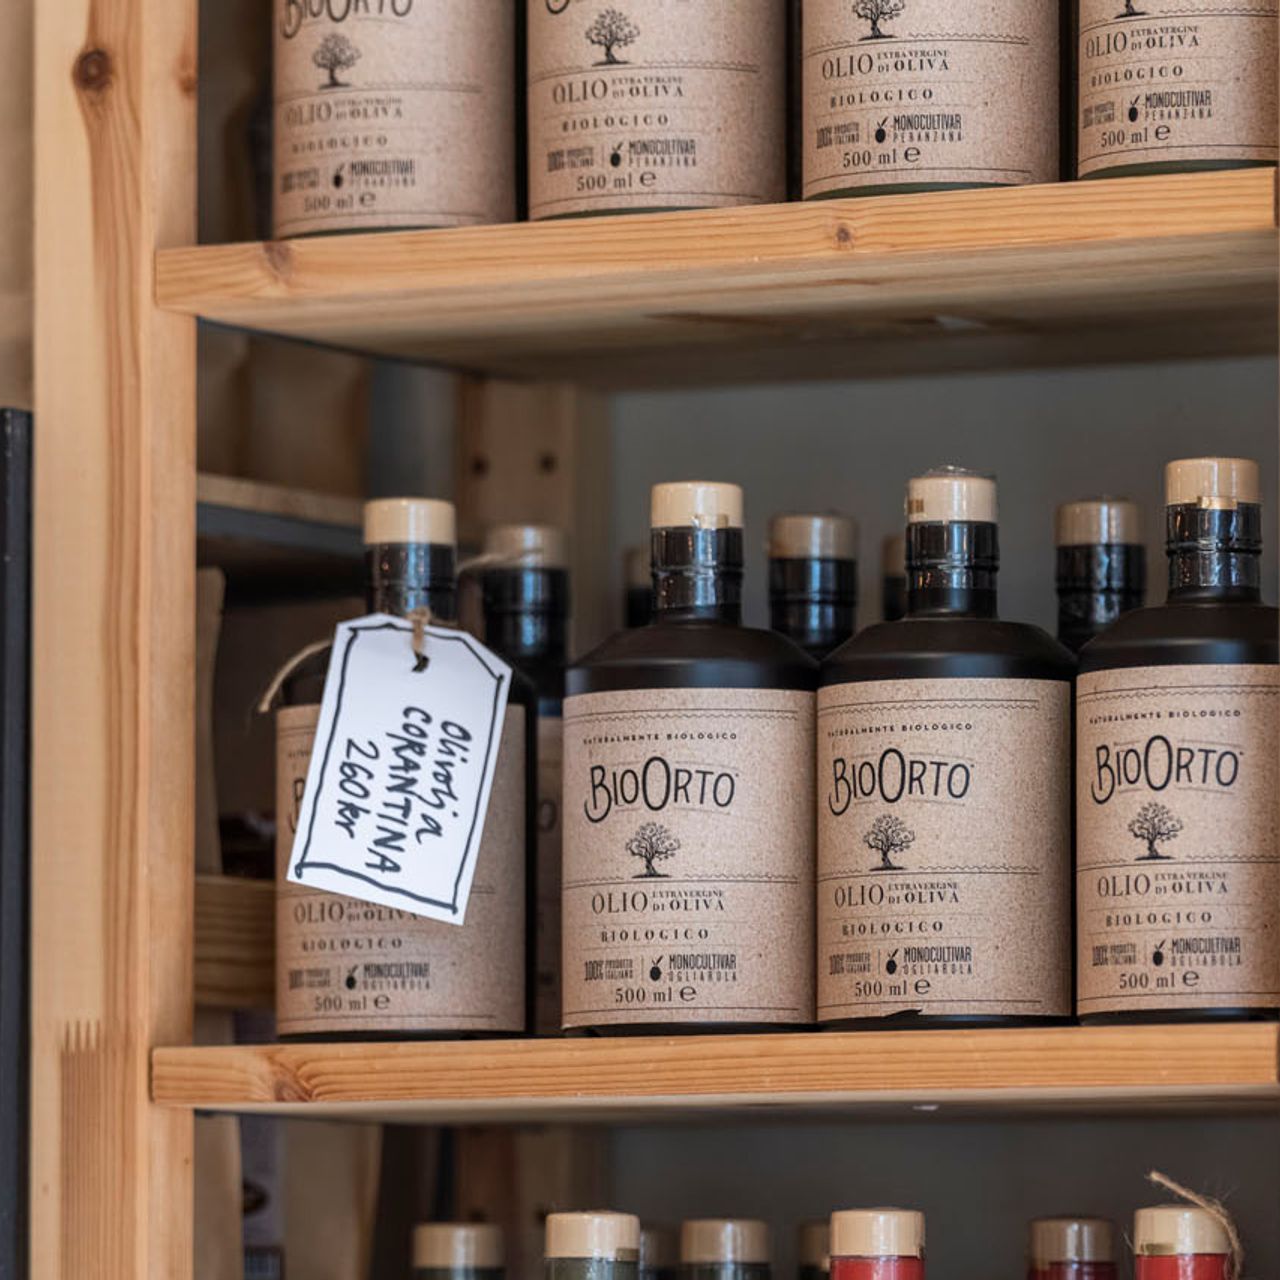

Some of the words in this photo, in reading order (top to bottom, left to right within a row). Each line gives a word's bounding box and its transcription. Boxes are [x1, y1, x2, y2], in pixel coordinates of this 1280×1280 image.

[1086, 31, 1127, 59] OLIO
[1146, 34, 1199, 49] OLIVA
[822, 52, 874, 80] OLIO
[894, 56, 950, 73] OLIVA
[1091, 65, 1184, 87] BIOLOGICO
[552, 78, 607, 105] OLIO
[629, 81, 684, 98] OLIVA
[830, 87, 934, 108] BIOLOGICO
[1145, 89, 1212, 108] MONOCULTIVAR
[562, 113, 670, 133] BIOLOGICO
[893, 114, 962, 132] MONOCULTIVAR
[1100, 129, 1126, 148] 500
[1131, 128, 1148, 144] ml
[628, 139, 696, 157] MONOCULTIVAR
[842, 150, 874, 168] 500
[878, 147, 897, 165] ml
[576, 173, 607, 192] 500
[612, 172, 633, 188] ml
[1169, 710, 1241, 718] BIOLOGICO
[667, 732, 737, 740] BIOLOGICO
[902, 723, 973, 732] BIOLOGICO
[1098, 874, 1151, 897] OLIO
[1172, 882, 1228, 894] OLIVA
[591, 892, 648, 915] OLIO
[834, 884, 884, 908] OLIO
[905, 892, 959, 903] OLIVA
[293, 901, 345, 925] OLIO
[670, 900, 725, 911] OLIVA
[842, 921, 943, 936] BIOLOGICO
[1106, 913, 1212, 927] BIOLOGICO
[601, 929, 709, 942] BIOLOGICO
[301, 937, 403, 952] BIOLOGICO
[1171, 937, 1241, 953] MONOCULTIVAR
[669, 954, 737, 970] MONOCULTIVAR
[904, 946, 972, 962] MONOCULTIVAR
[855, 981, 882, 997] 500
[889, 980, 907, 995] ml
[1119, 973, 1148, 988] 500
[1156, 972, 1175, 987] ml
[314, 995, 343, 1011] 500
[348, 994, 367, 1011] ml
[615, 988, 646, 1003] 500
[653, 985, 672, 1002] ml
